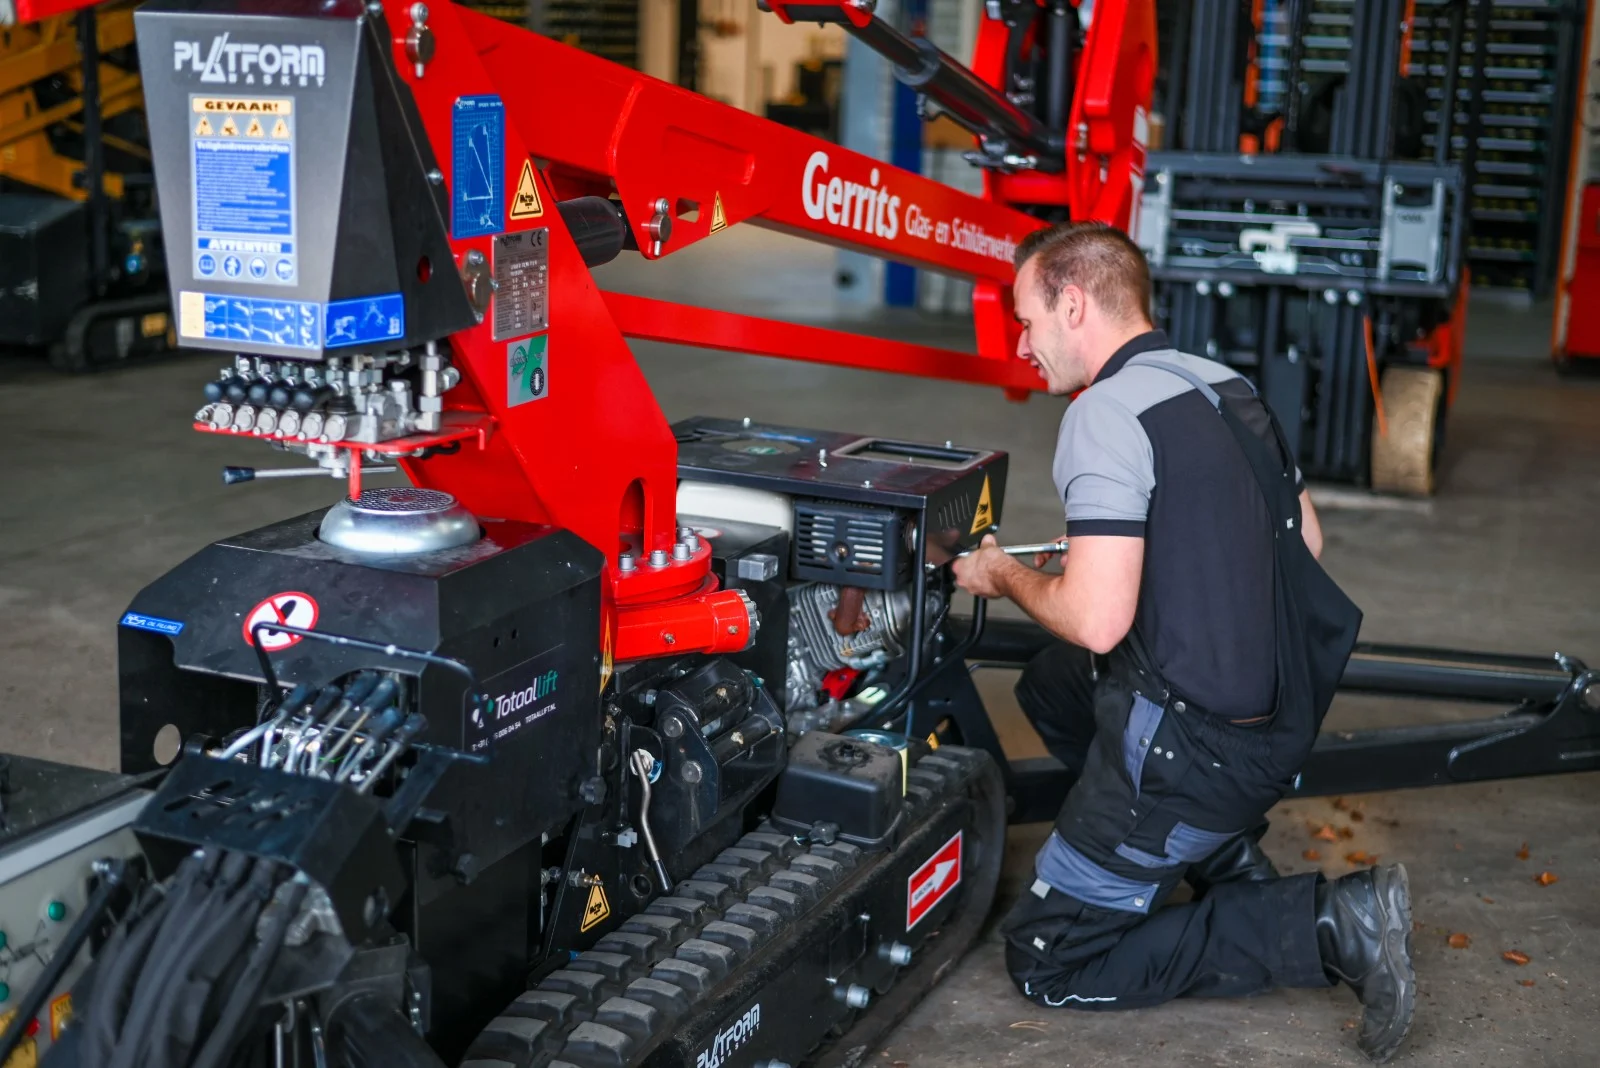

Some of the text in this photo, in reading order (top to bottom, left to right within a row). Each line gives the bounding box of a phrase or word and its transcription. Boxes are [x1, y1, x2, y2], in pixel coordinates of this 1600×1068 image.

[173, 31, 325, 82] PLATFORM
[205, 101, 279, 112] GEVAAR!
[802, 151, 902, 241] Gerrits
[905, 204, 934, 240] Glas-
[935, 221, 950, 245] en
[496, 670, 558, 720] Totaallift
[525, 703, 556, 723] TOTAALLIFT.NL
[697, 1003, 760, 1068] PLATFORM
